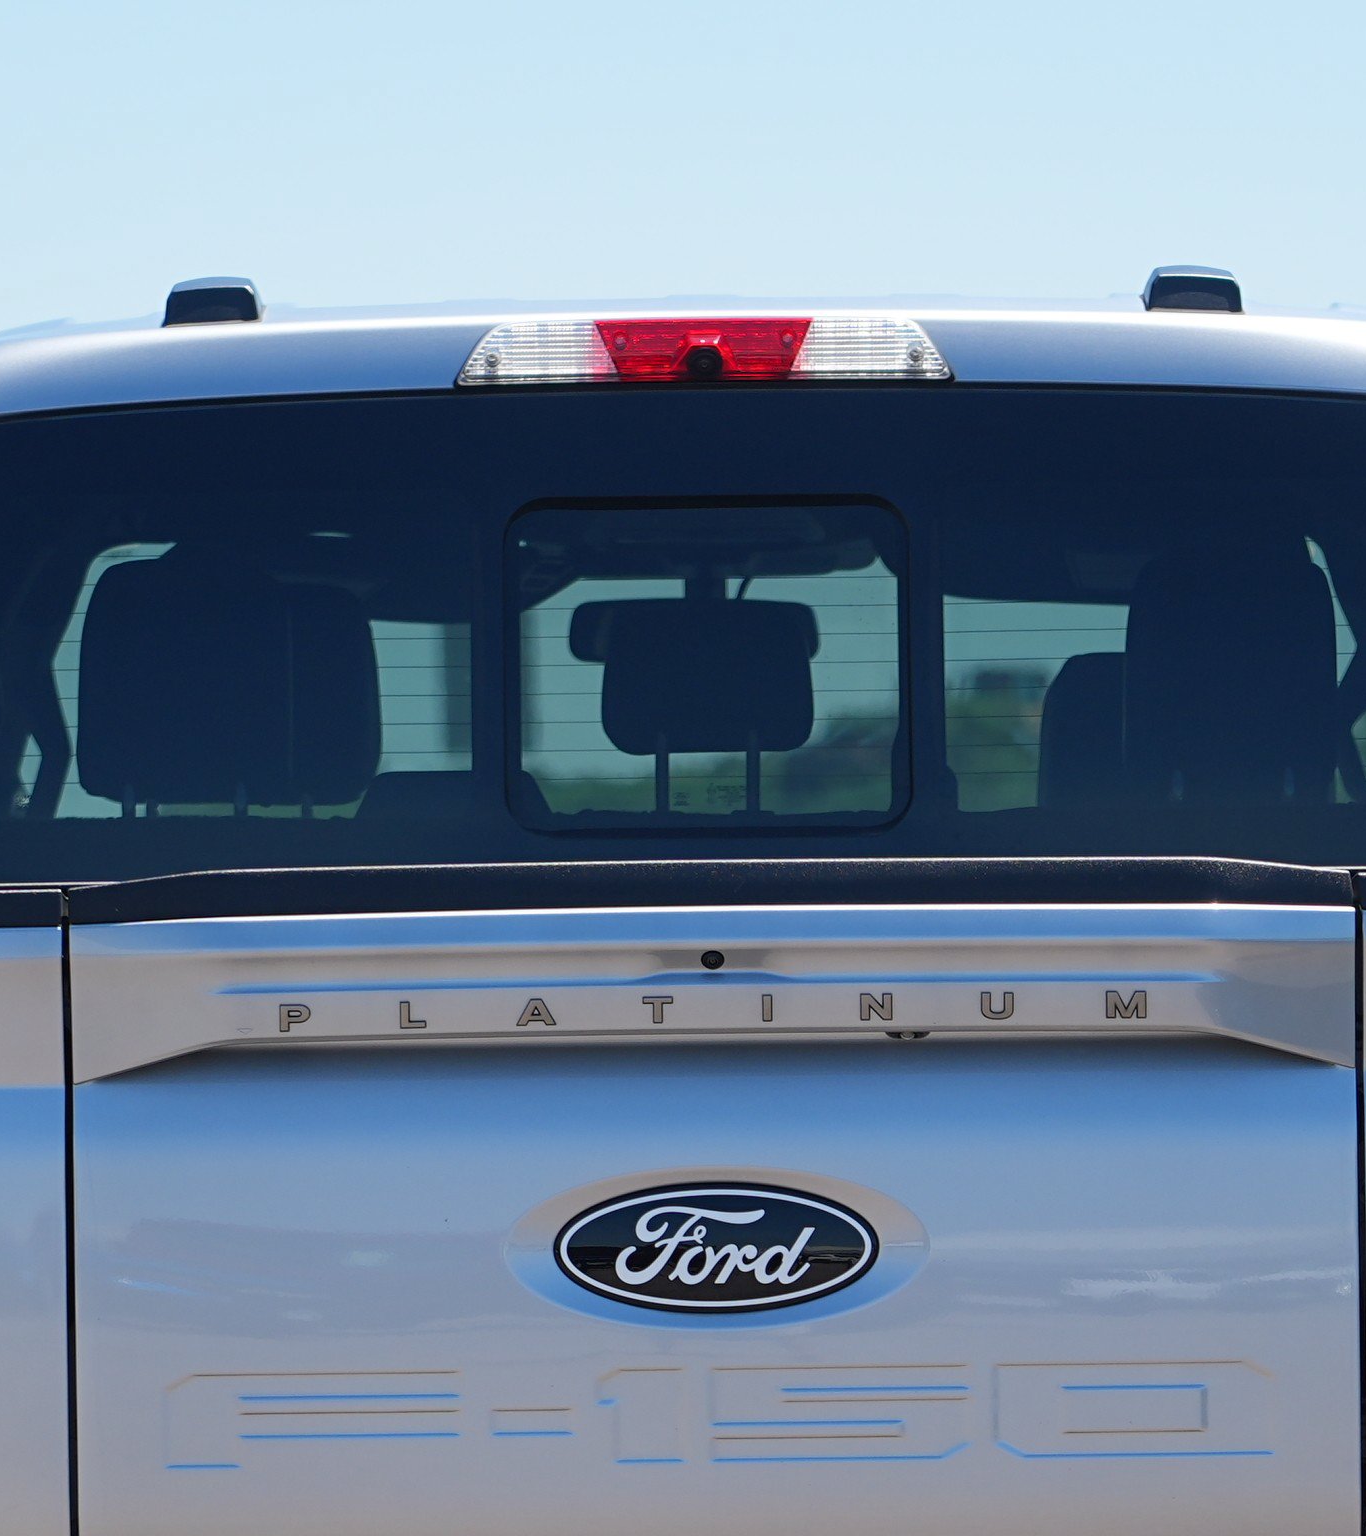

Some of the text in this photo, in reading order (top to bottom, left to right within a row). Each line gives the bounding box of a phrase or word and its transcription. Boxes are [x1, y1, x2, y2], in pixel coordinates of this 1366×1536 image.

[278, 990, 1147, 1033] PLATINUM
[615, 1206, 815, 1285] Ford
[166, 1360, 1273, 1469] F-150
